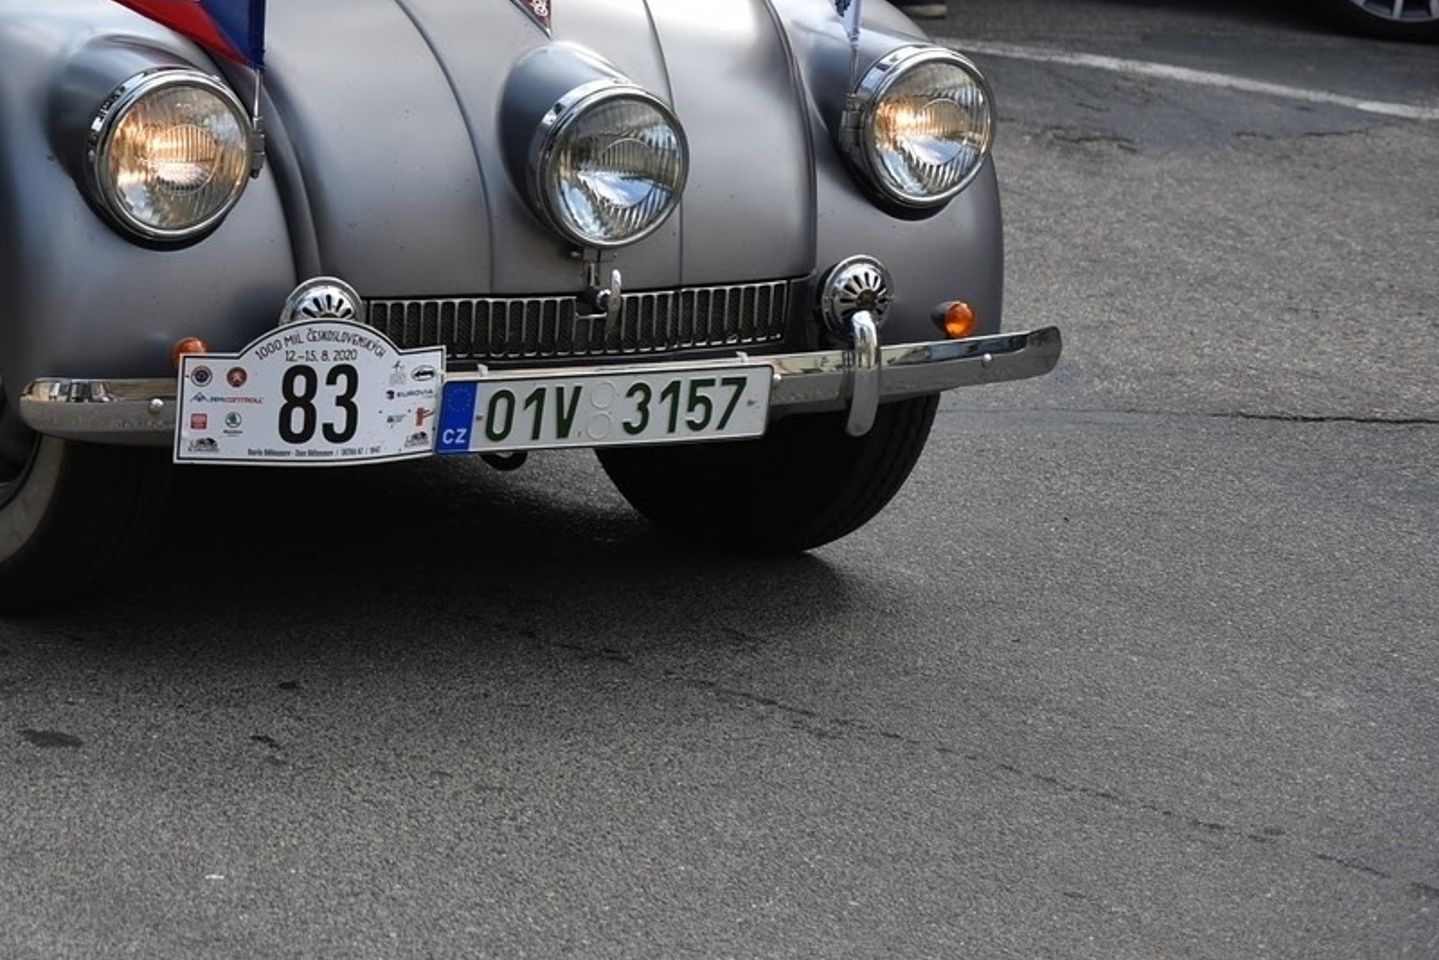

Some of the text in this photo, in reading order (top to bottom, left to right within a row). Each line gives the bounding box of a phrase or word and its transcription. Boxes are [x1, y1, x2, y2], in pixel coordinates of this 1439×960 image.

[254, 327, 387, 360] 1000 MIL ČESKOSLOVENSKÝCH
[321, 350, 332, 362] 8.
[333, 348, 359, 361] 2020
[278, 363, 359, 445] 83
[442, 376, 748, 445] CZ 01V 3157
